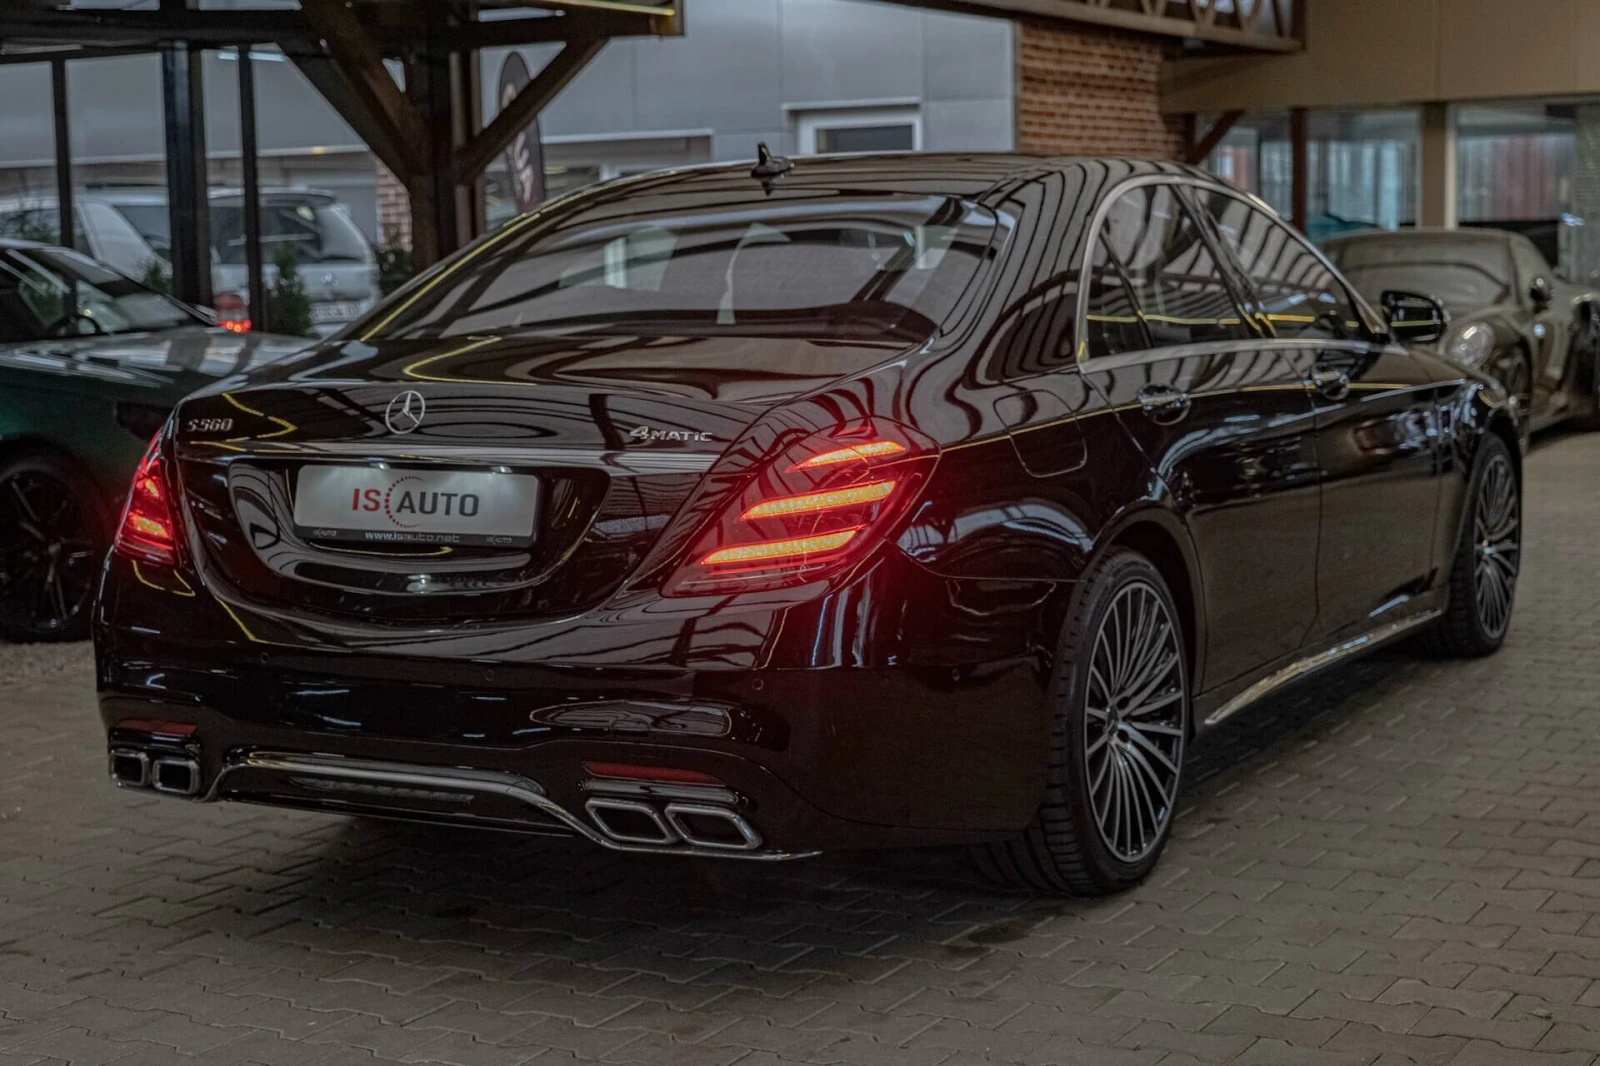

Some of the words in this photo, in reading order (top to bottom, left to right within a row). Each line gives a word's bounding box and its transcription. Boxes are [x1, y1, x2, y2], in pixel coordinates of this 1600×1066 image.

[629, 426, 713, 442] 4MATIC
[352, 488, 381, 512] IS
[396, 490, 480, 517] AUTO
[365, 531, 460, 544] www.isauto.net
